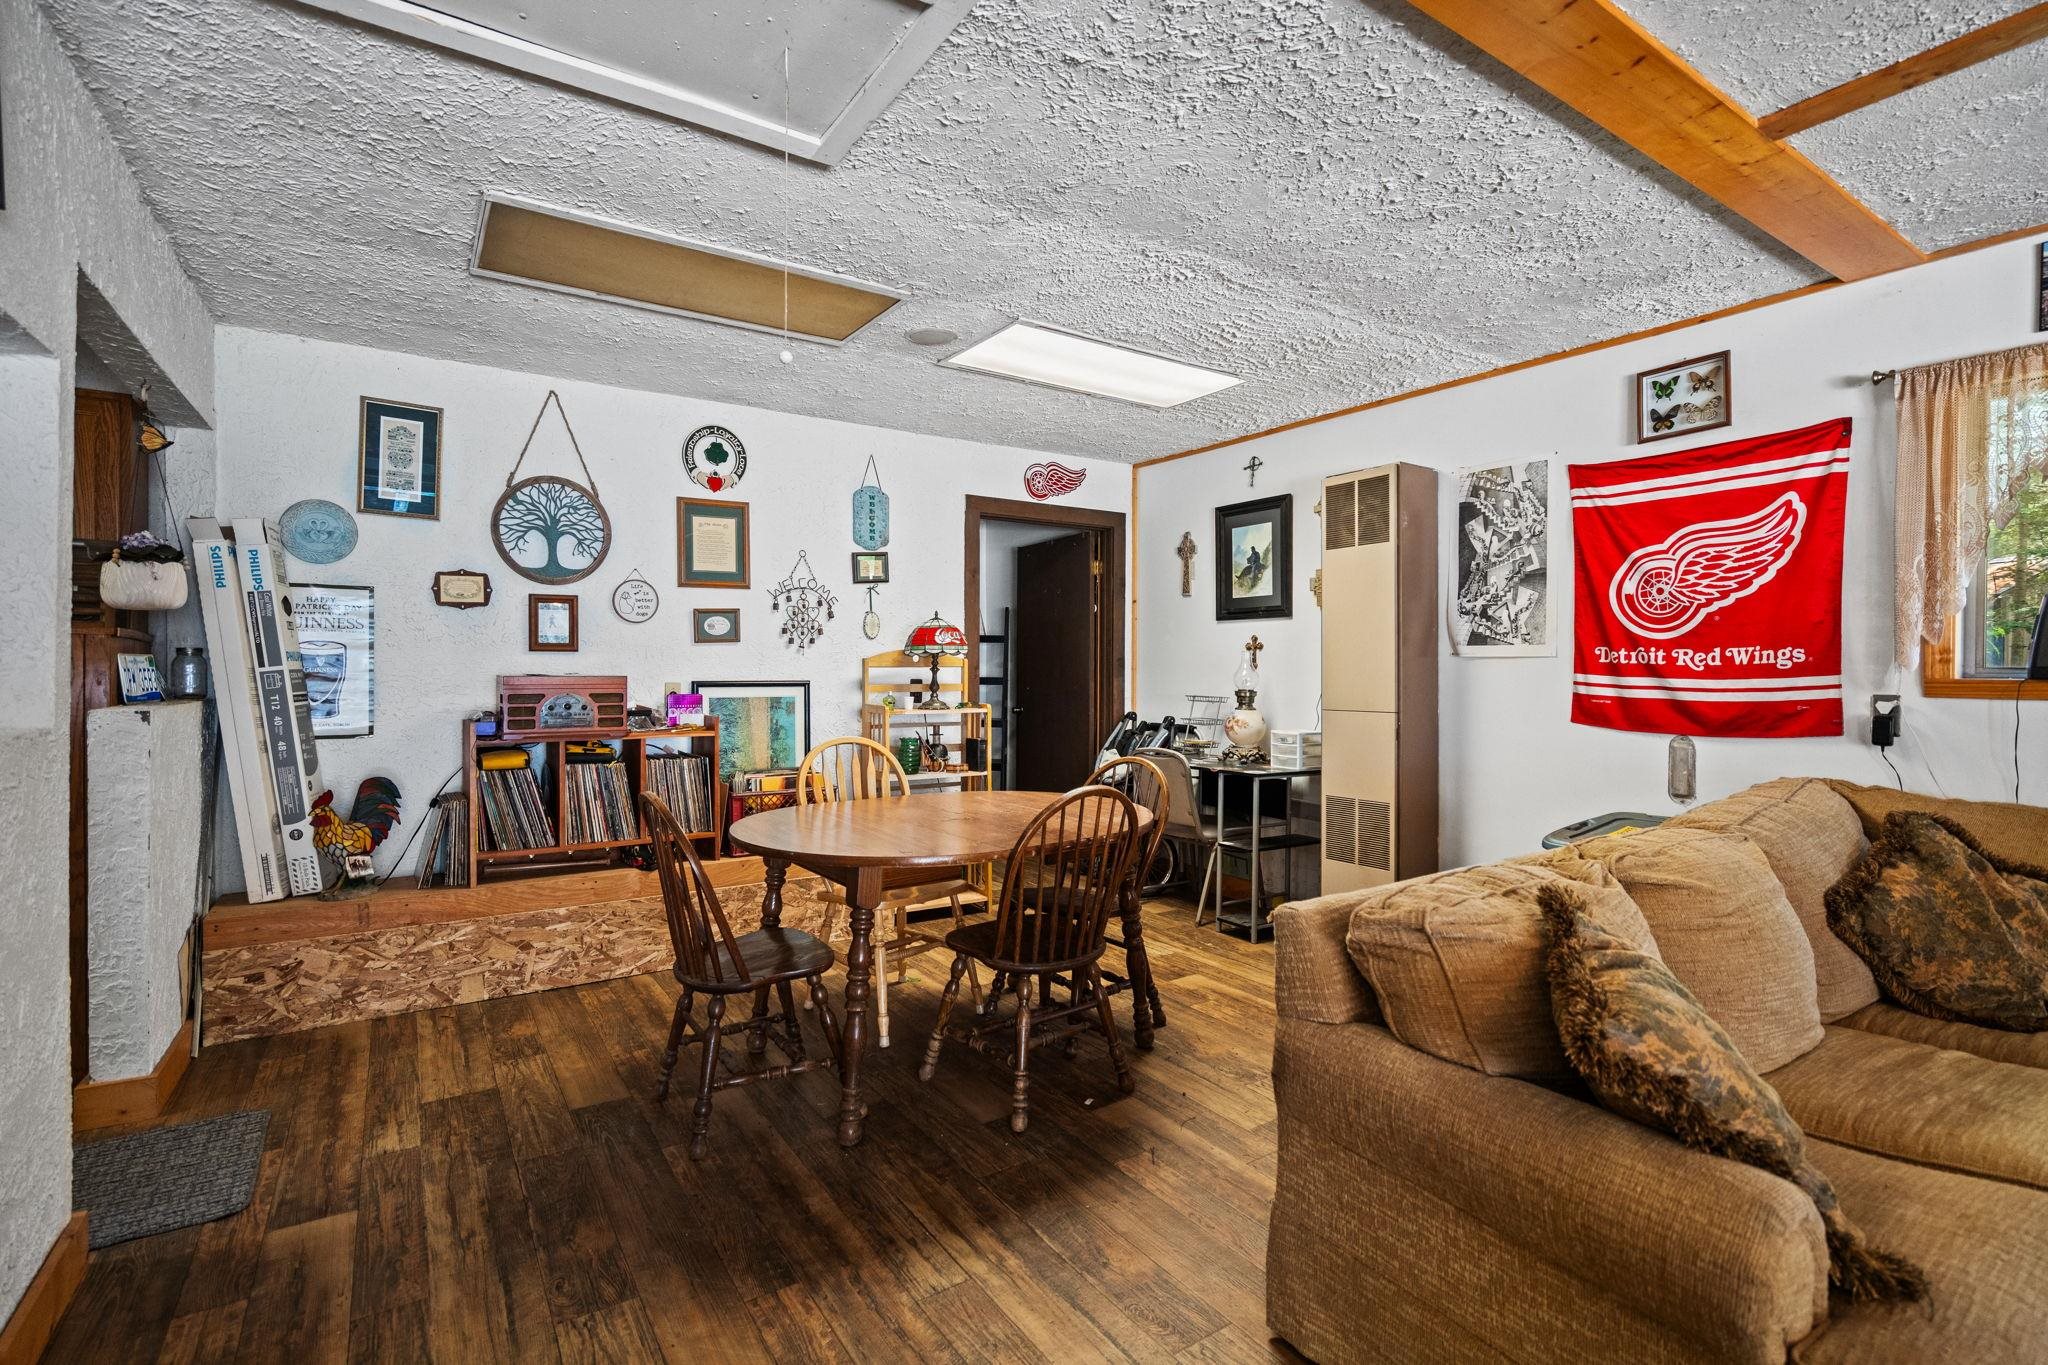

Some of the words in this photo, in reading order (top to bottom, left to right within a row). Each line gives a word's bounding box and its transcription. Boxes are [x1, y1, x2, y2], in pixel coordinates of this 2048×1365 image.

[209, 545, 227, 588] PHILIPS
[247, 549, 264, 592] PHILIPS
[766, 578, 839, 606] WELCOME
[296, 616, 365, 630] UINNESS
[1594, 646, 1667, 665] Detroit
[1671, 647, 1722, 671] Red
[1725, 646, 1806, 670] Wings
[270, 694, 281, 711] T12
[273, 715, 283, 726] 40
[277, 740, 287, 751] 48
